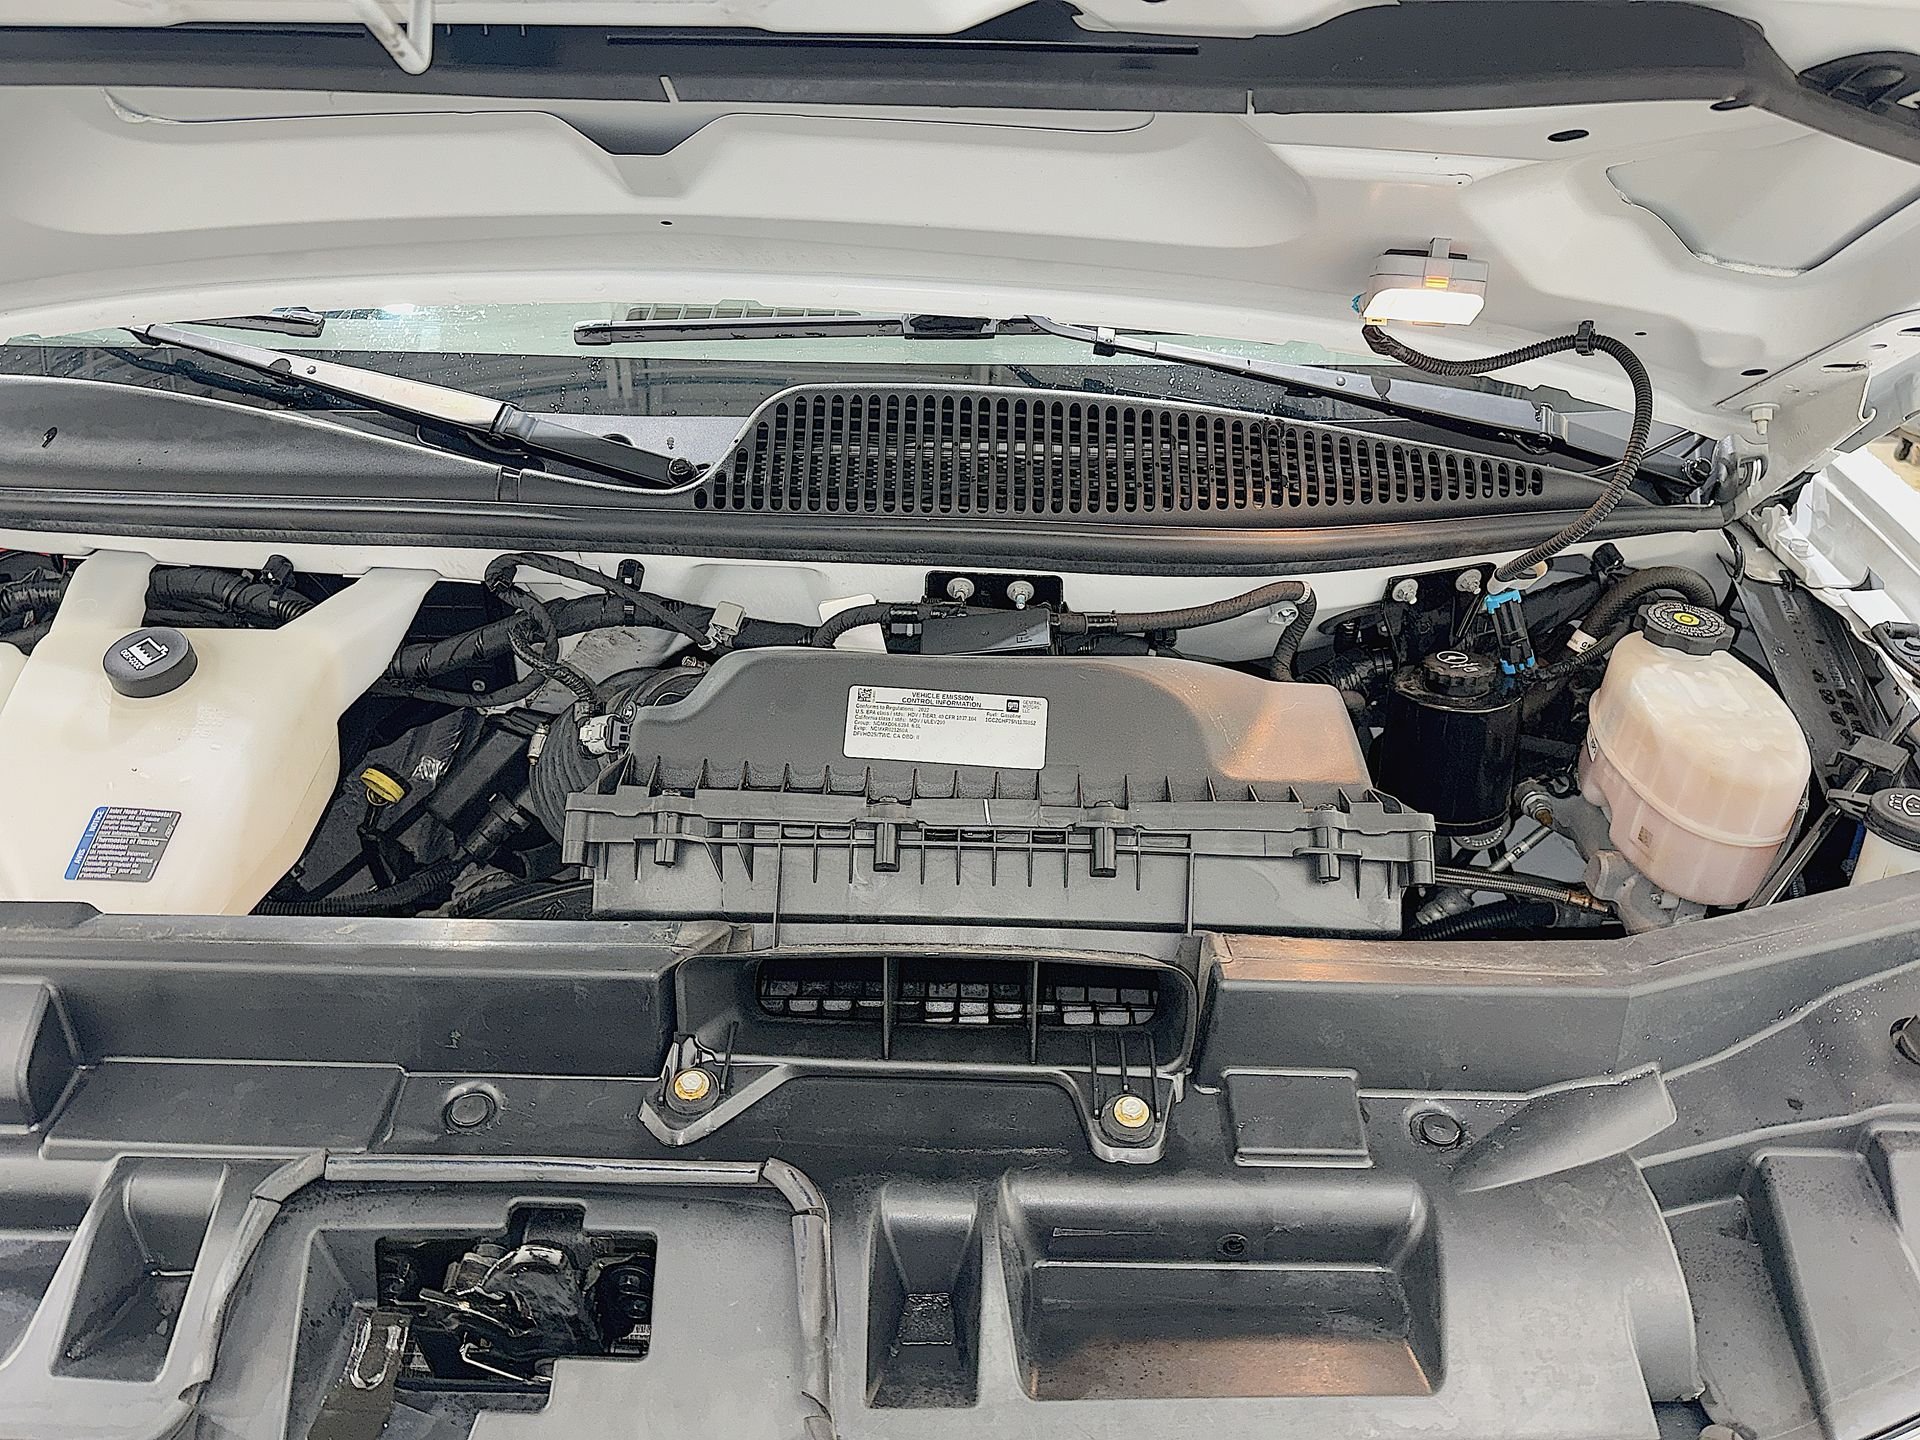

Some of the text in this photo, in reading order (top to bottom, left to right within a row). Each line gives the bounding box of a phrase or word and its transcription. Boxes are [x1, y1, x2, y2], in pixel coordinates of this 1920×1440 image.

[936, 700, 982, 708] INFORMATION
[88, 809, 105, 832] NOTICE
[74, 849, 86, 864] AVIS
